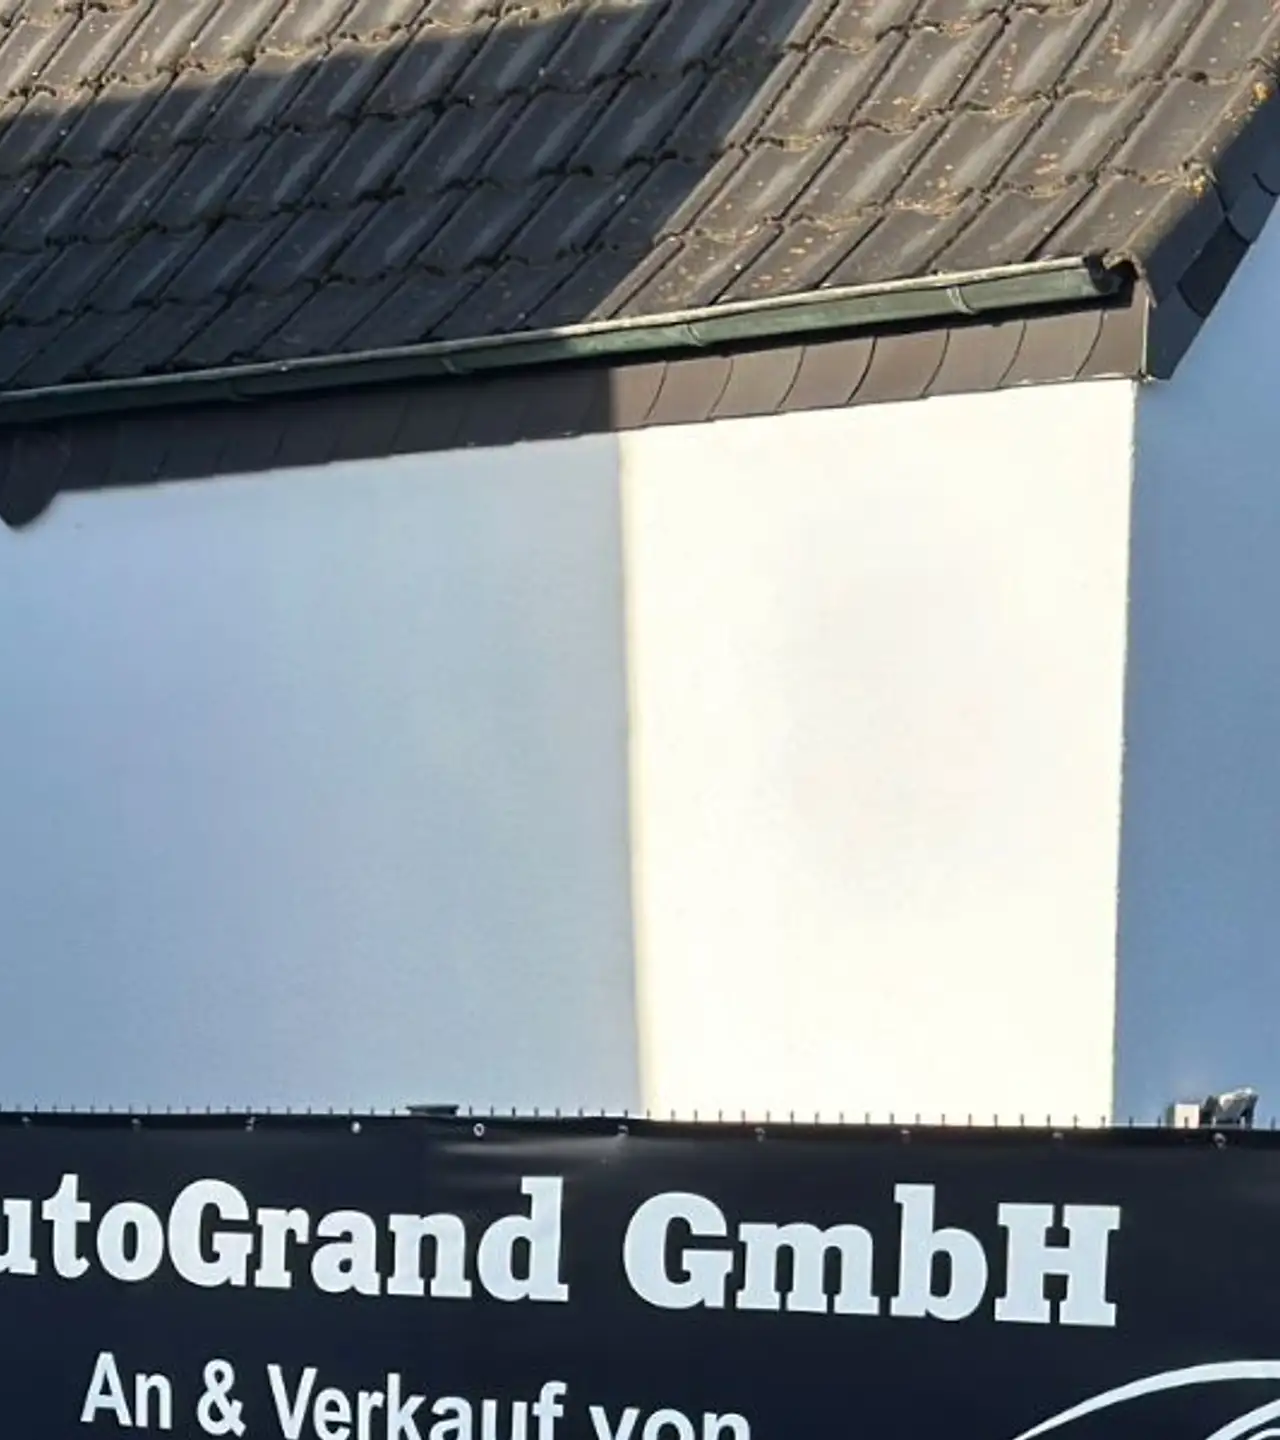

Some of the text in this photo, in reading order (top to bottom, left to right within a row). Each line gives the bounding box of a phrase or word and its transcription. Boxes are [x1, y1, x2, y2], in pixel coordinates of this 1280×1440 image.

[623, 1184, 1121, 1327] GmbH
[81, 1352, 172, 1429] An
[197, 1359, 246, 1437] &
